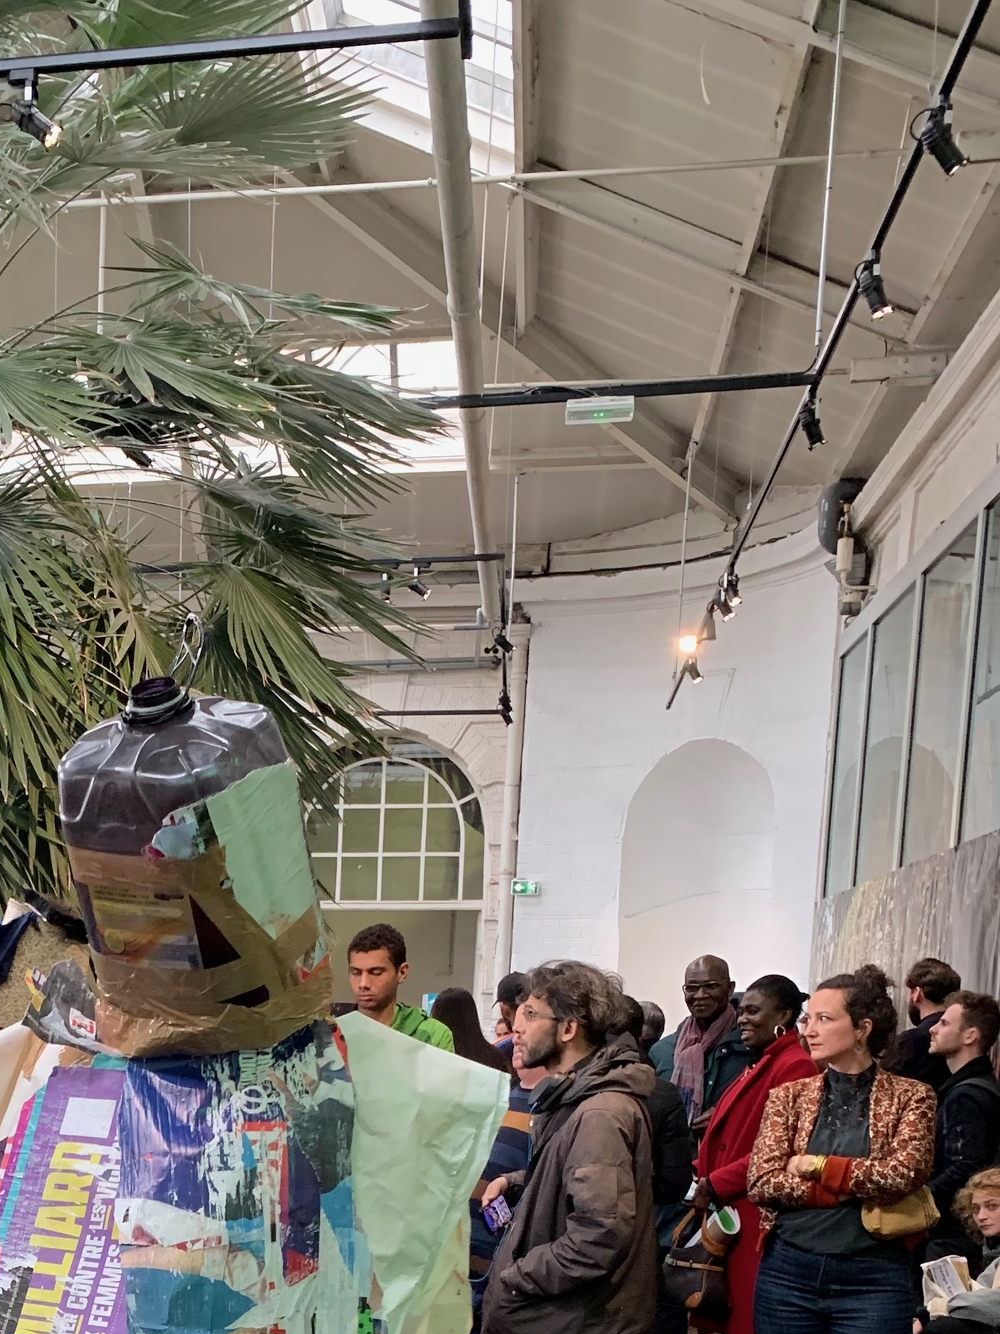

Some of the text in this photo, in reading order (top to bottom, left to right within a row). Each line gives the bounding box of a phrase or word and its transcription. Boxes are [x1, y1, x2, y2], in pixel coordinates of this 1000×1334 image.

[66, 1235, 105, 1309] CONTRE
[90, 1204, 107, 1228] LES
[87, 1244, 122, 1327] FEMMES
